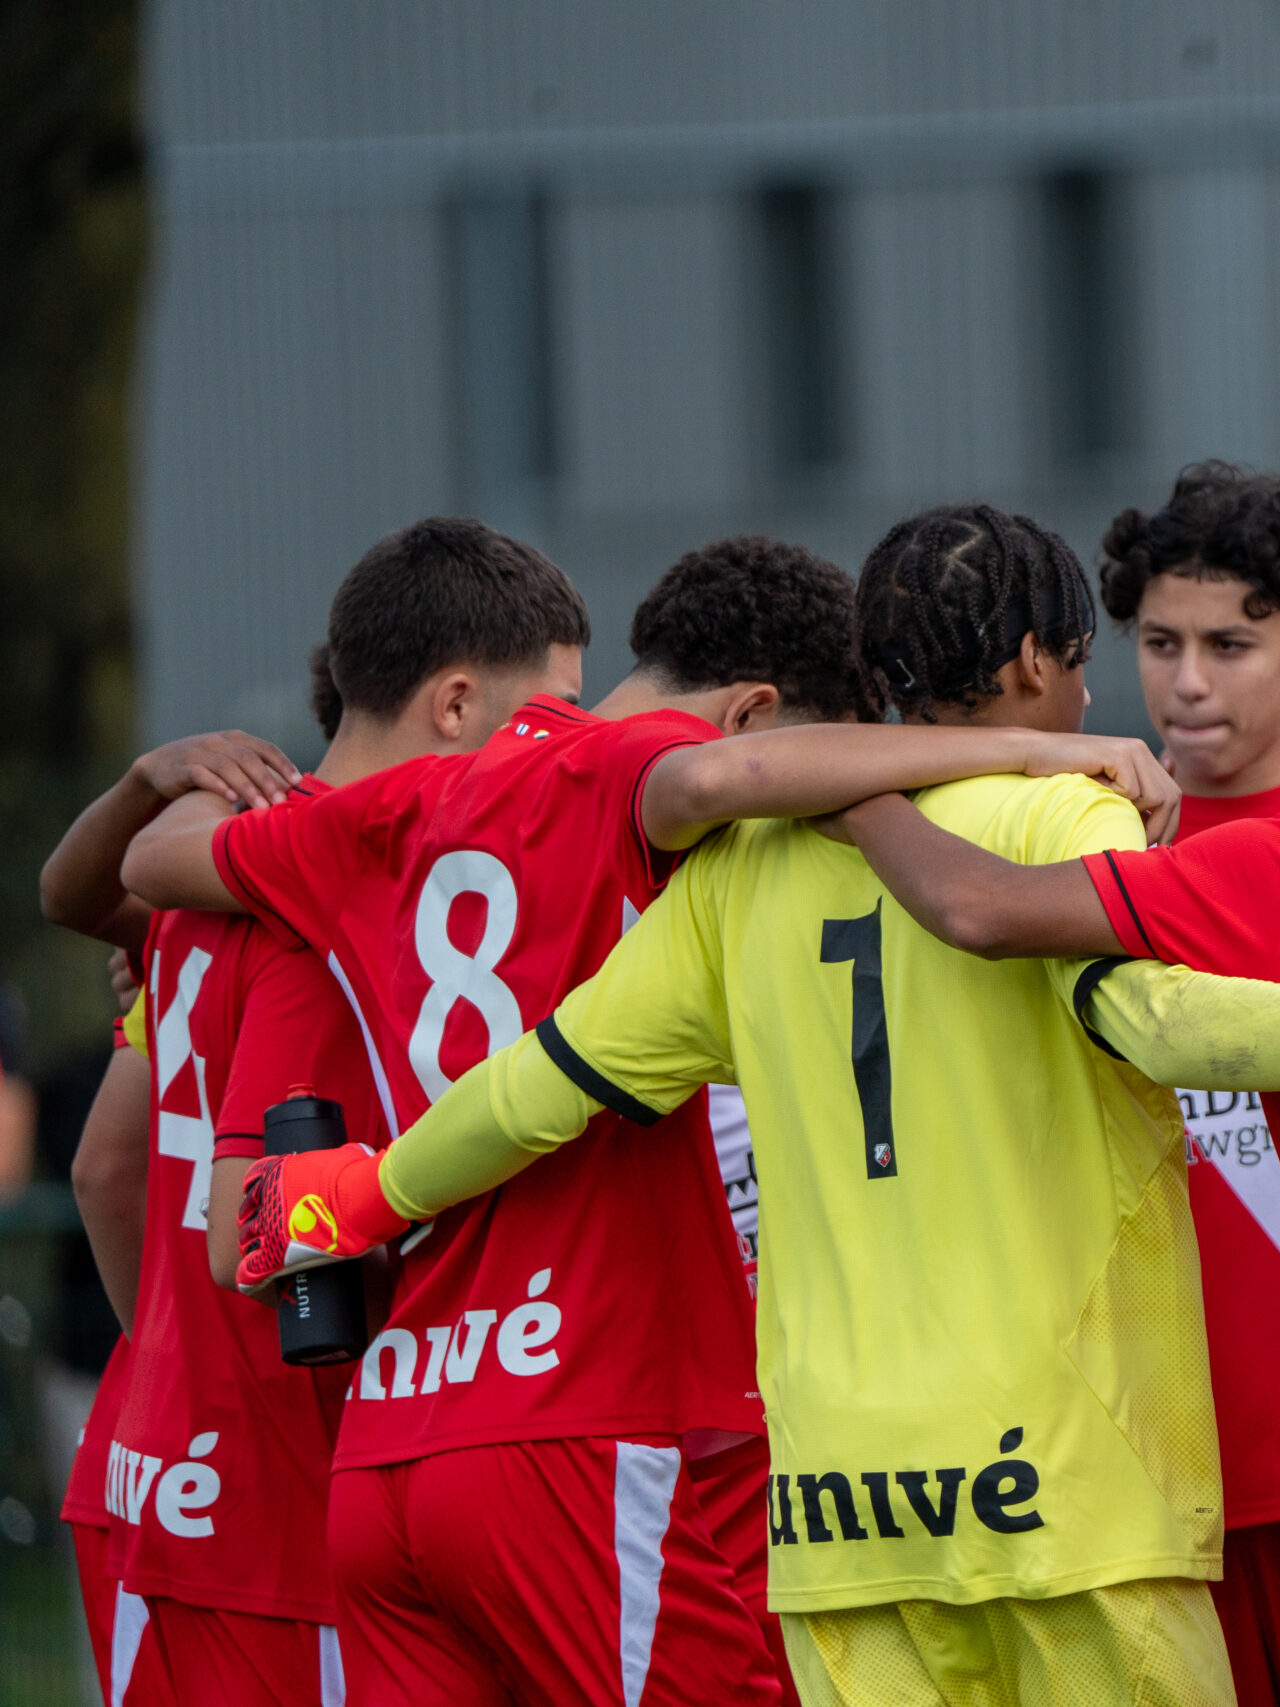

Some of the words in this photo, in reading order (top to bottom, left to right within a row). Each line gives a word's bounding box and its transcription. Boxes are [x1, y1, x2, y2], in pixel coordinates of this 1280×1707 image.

[408, 850, 524, 1106] 8
[821, 895, 898, 1180] 1
[345, 1267, 562, 1401] nivé
[767, 1426, 1045, 1546] univé
